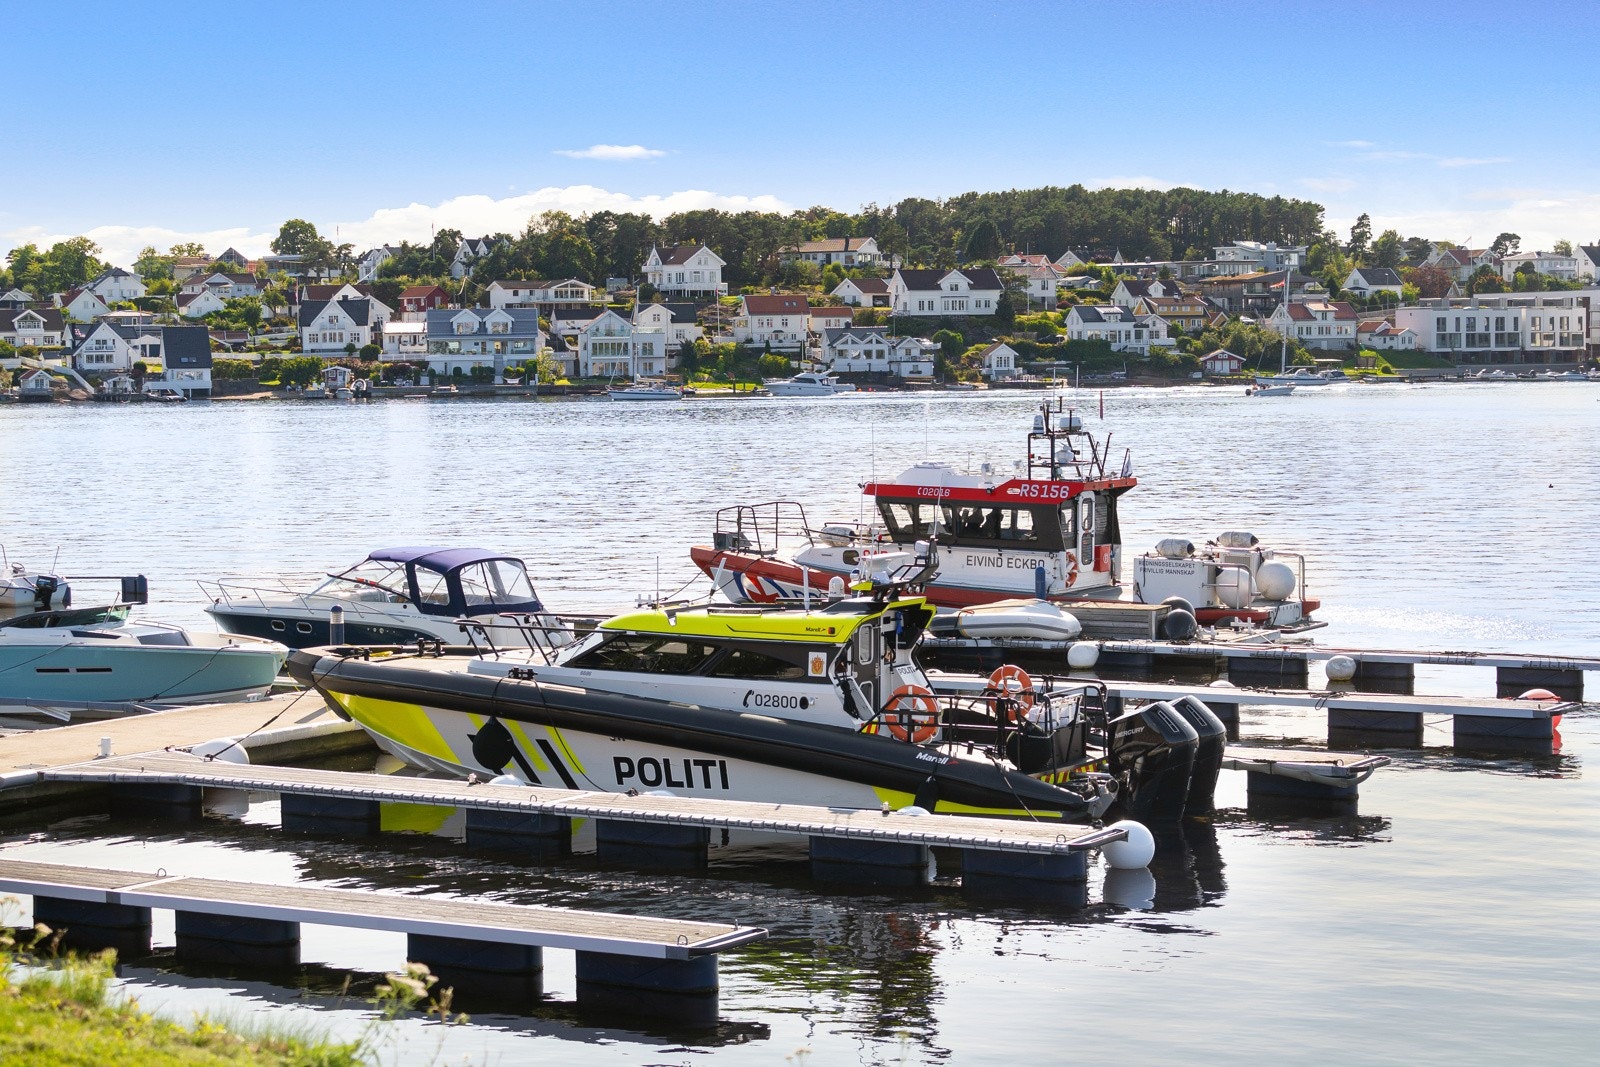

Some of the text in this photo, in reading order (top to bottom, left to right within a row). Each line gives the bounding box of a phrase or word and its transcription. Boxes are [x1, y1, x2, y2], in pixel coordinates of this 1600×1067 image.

[922, 487, 951, 497] 02016
[966, 555, 1045, 570] EIVIND ECKBO
[754, 693, 798, 709] 02800
[1114, 725, 1146, 739] MERCURY
[915, 751, 950, 765] Marell
[612, 756, 730, 790] POLITI
